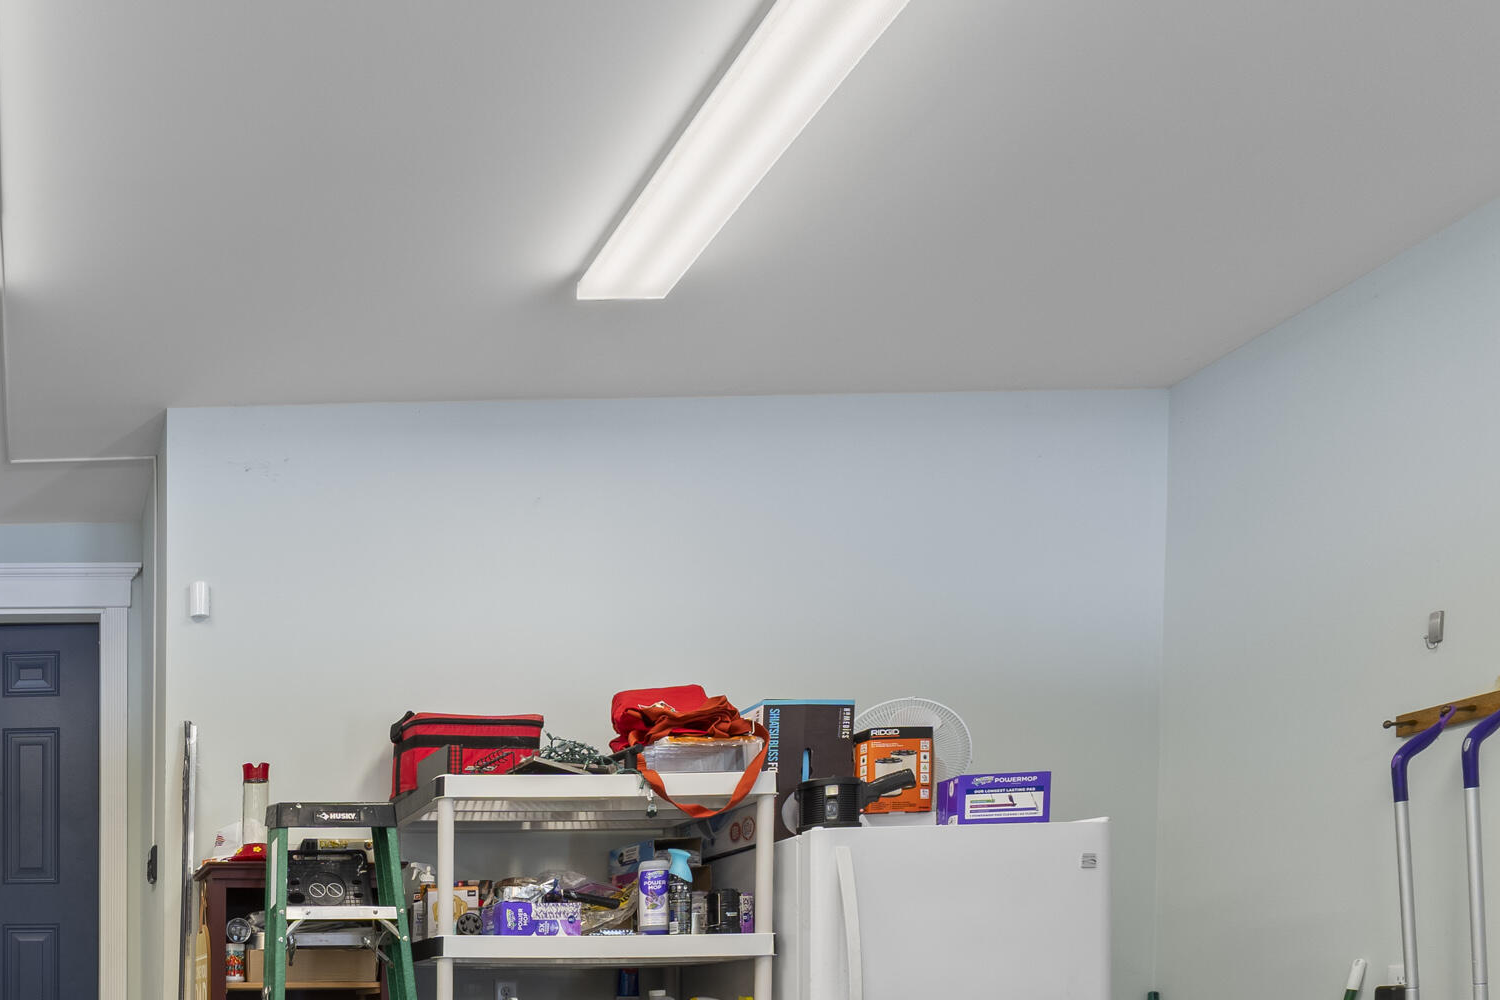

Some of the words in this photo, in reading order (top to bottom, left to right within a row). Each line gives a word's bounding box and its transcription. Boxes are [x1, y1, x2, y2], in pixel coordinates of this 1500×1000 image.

[769, 708, 781, 739] SHIATSU
[767, 741, 780, 761] BLISS
[329, 812, 356, 820] HUSKY
